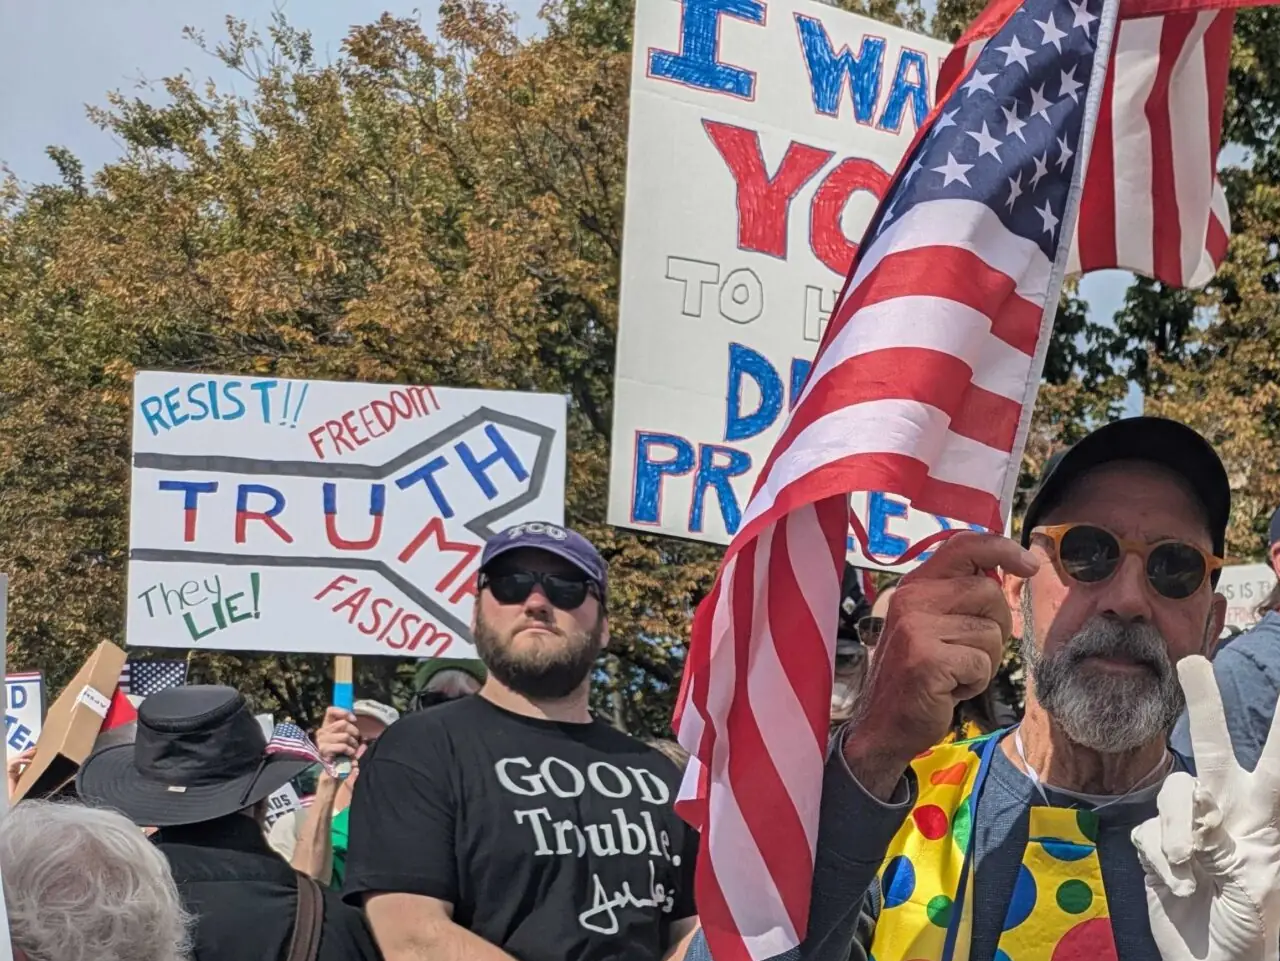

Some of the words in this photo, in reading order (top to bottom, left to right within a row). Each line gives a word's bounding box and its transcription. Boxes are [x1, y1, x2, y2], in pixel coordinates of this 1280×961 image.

[646, 0, 768, 102] I
[792, 12, 948, 137] WA
[700, 118, 892, 278] YO
[664, 255, 764, 324] TO
[141, 380, 309, 436] RESIST!!
[138, 574, 222, 618] They
[182, 572, 261, 642] LIE!
[494, 756, 670, 805] GOOD
